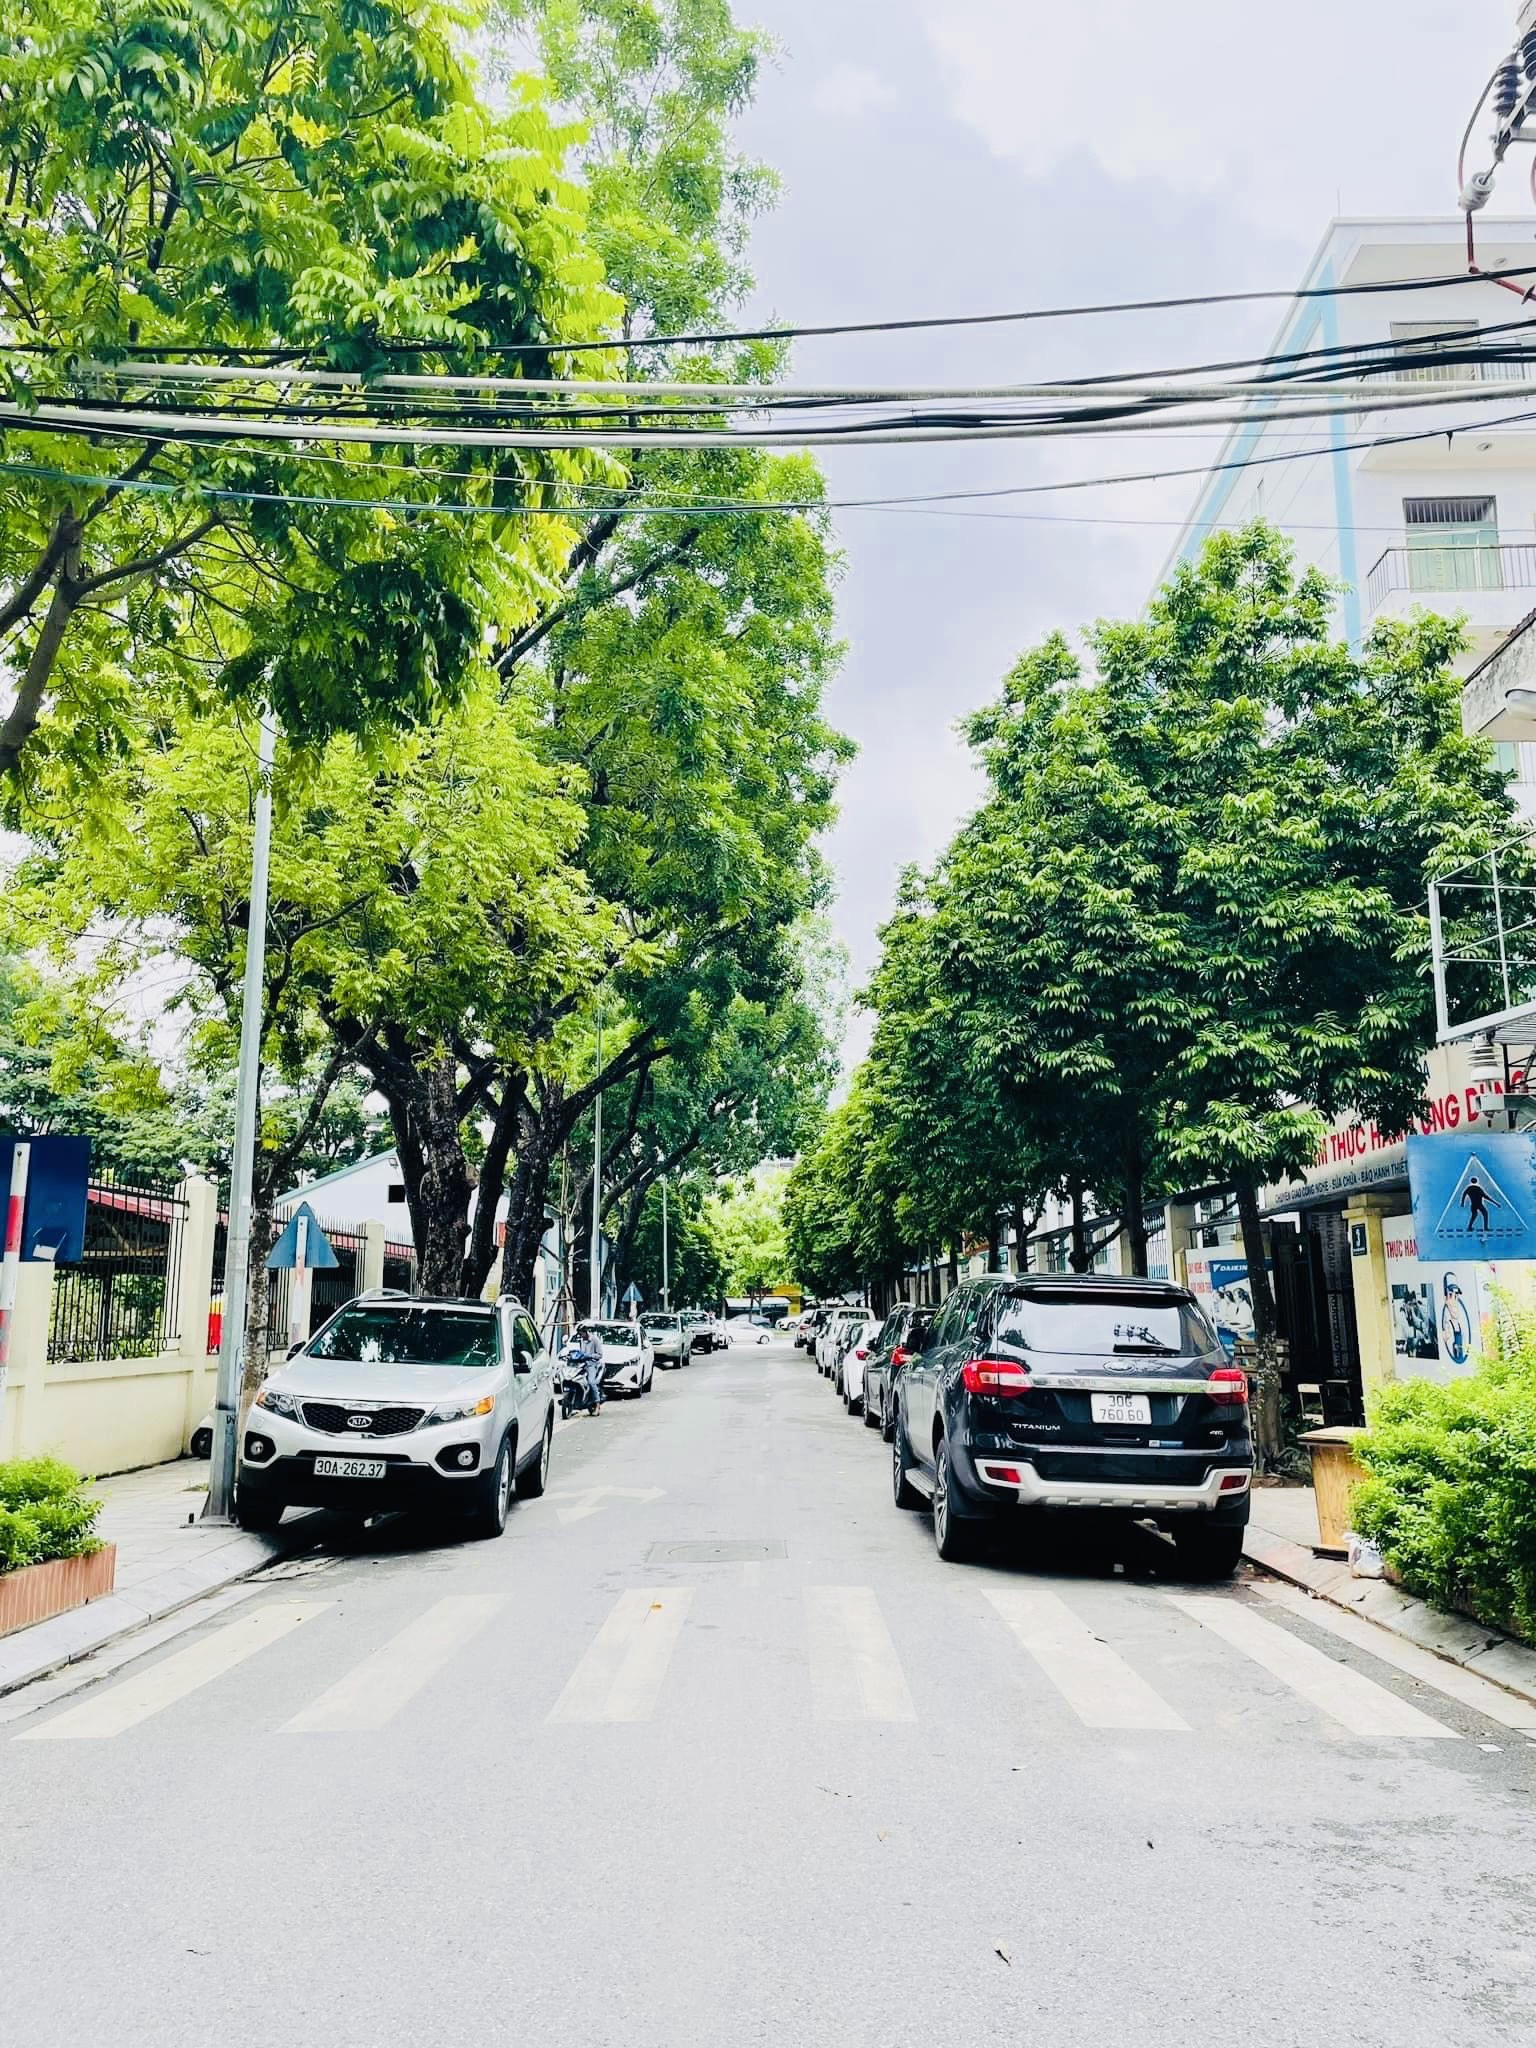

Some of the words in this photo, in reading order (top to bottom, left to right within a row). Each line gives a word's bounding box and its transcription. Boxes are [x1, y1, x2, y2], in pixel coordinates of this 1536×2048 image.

[1220, 1264, 1248, 1272] DAIKIN
[1108, 1393, 1132, 1408] 30G
[1100, 1409, 1144, 1422] 760.60
[1011, 1422, 1061, 1432] TITANIUM
[316, 1460, 383, 1477] 30A-262.37
